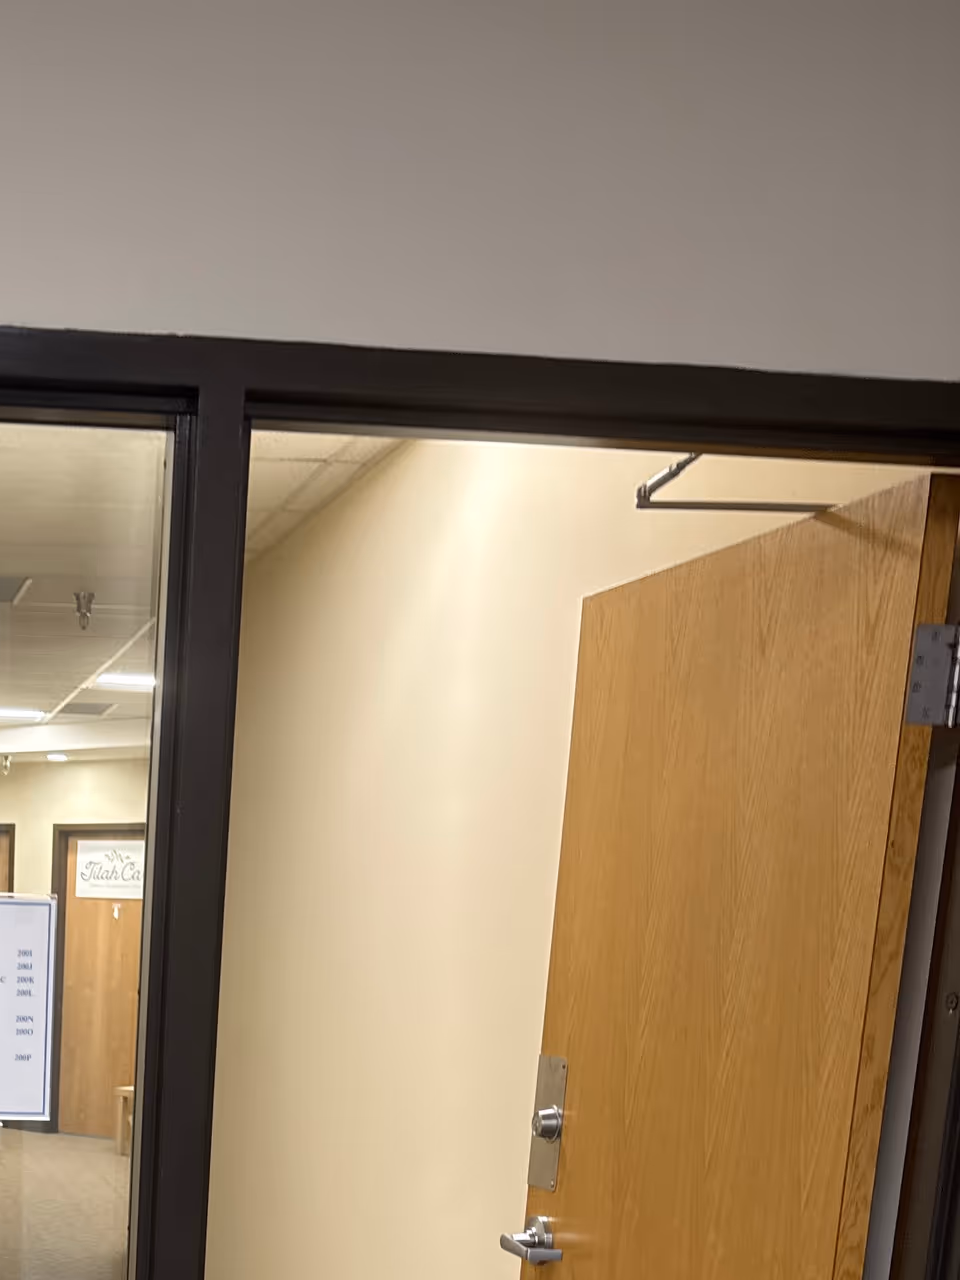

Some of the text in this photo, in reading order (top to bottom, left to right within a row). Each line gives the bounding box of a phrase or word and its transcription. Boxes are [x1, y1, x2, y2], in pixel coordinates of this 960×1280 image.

[121, 861, 141, 882] Ca
[16, 976, 34, 984] 200K
[16, 1015, 34, 1023] 200N
[14, 1054, 32, 1062] 200P
